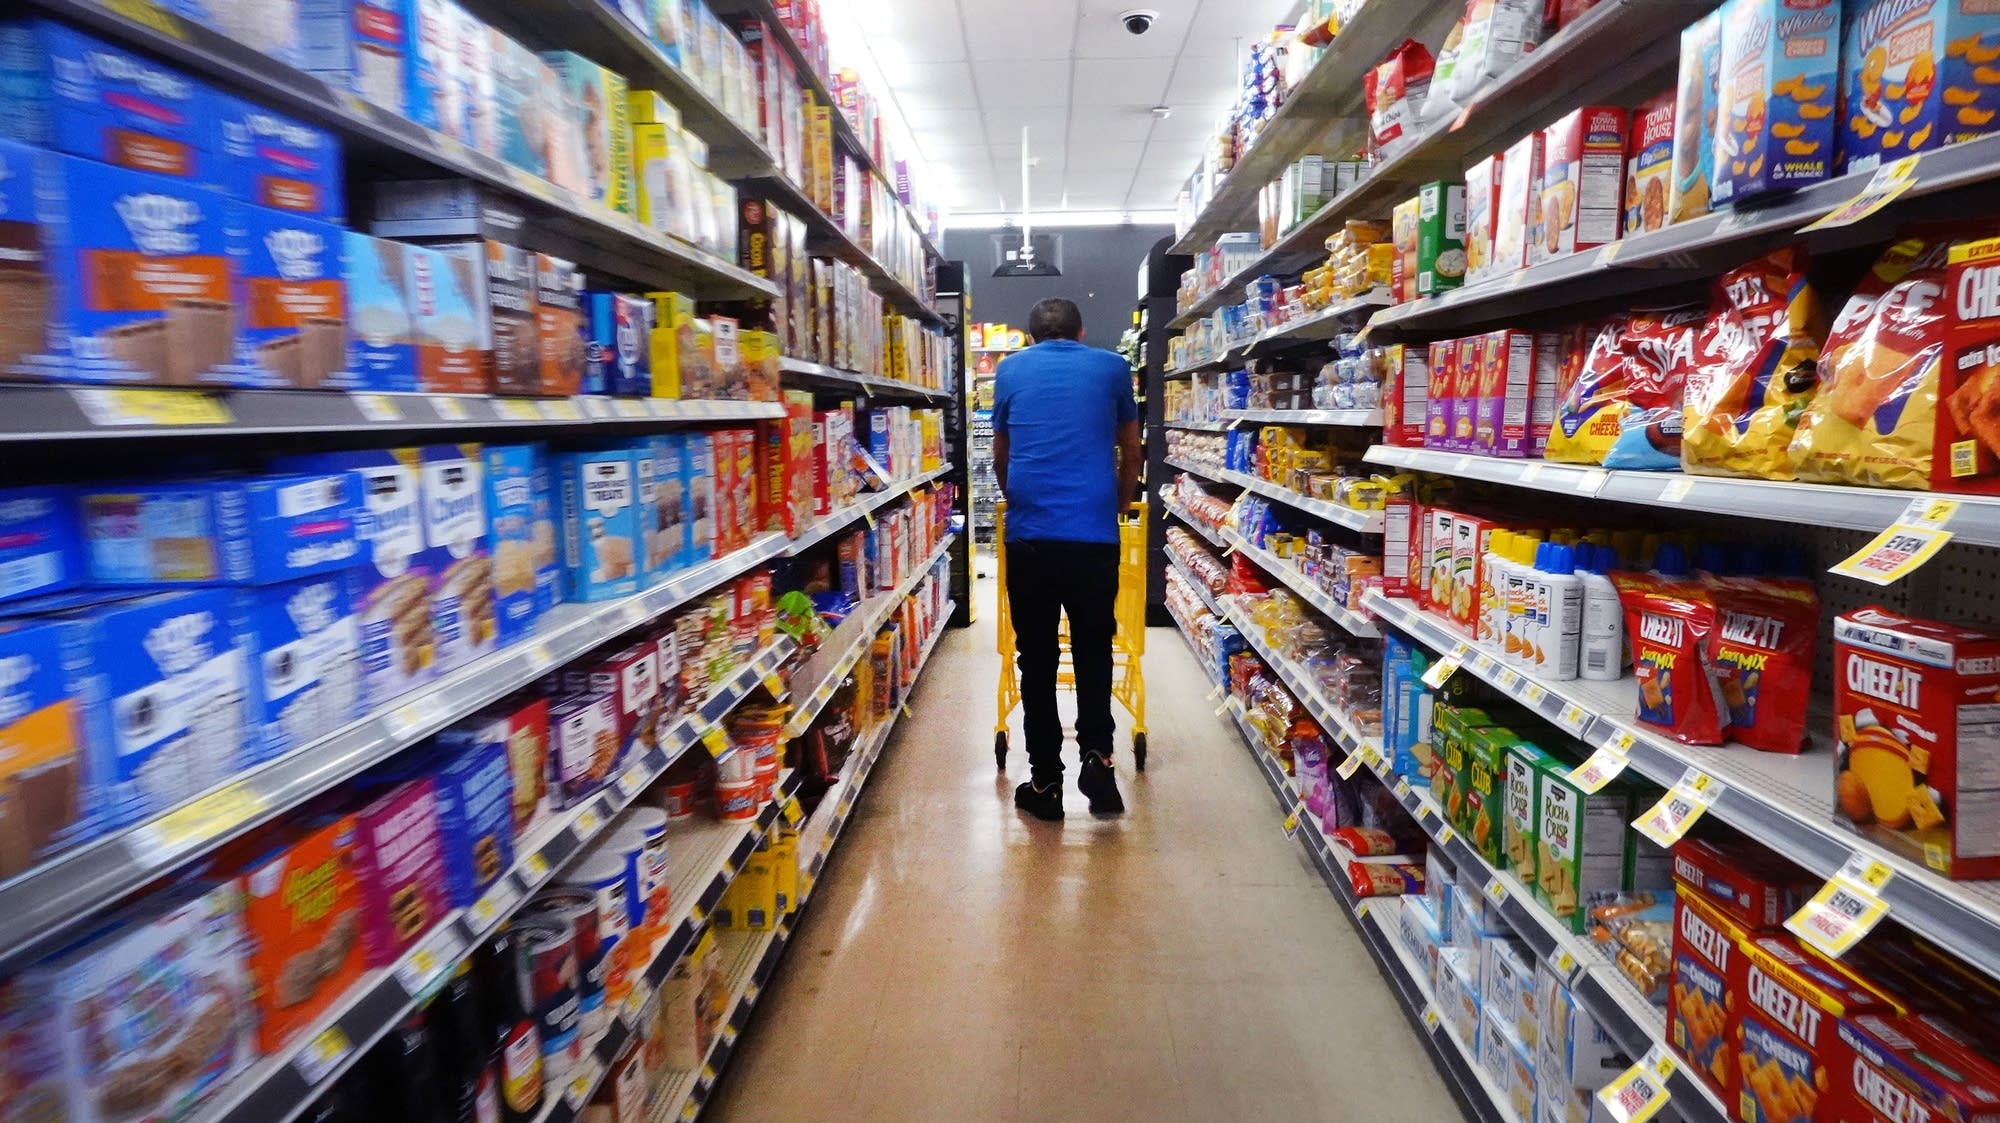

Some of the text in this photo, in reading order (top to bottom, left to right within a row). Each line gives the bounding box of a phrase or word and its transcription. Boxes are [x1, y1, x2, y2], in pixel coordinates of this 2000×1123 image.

[1592, 116, 1617, 125] TOWN
[1645, 104, 1673, 128] TOWN
[1590, 124, 1618, 133] HOUSE
[1642, 122, 1672, 147] HOUSE
[1773, 161, 1824, 172] A WHALE
[1589, 422, 1620, 437] CHEESE
[1884, 535, 1927, 554] EVEN
[1640, 611, 1685, 649] CHEEZ-IT
[1847, 653, 1923, 710] CHEEZ-IT
[1446, 739, 1463, 772] CLUB
[1471, 760, 1492, 796] CLUB
[1546, 796, 1564, 820] RICH
[1545, 818, 1568, 839] CRISP
[1675, 855, 1704, 889] CHEEZ-IT
[1829, 891, 1866, 917] EVEN
[1681, 903, 1731, 974] CHEEZ-IT
[1747, 963, 1822, 1048] CHEEZ-IT
[1632, 1078, 1655, 1101] EVEN
